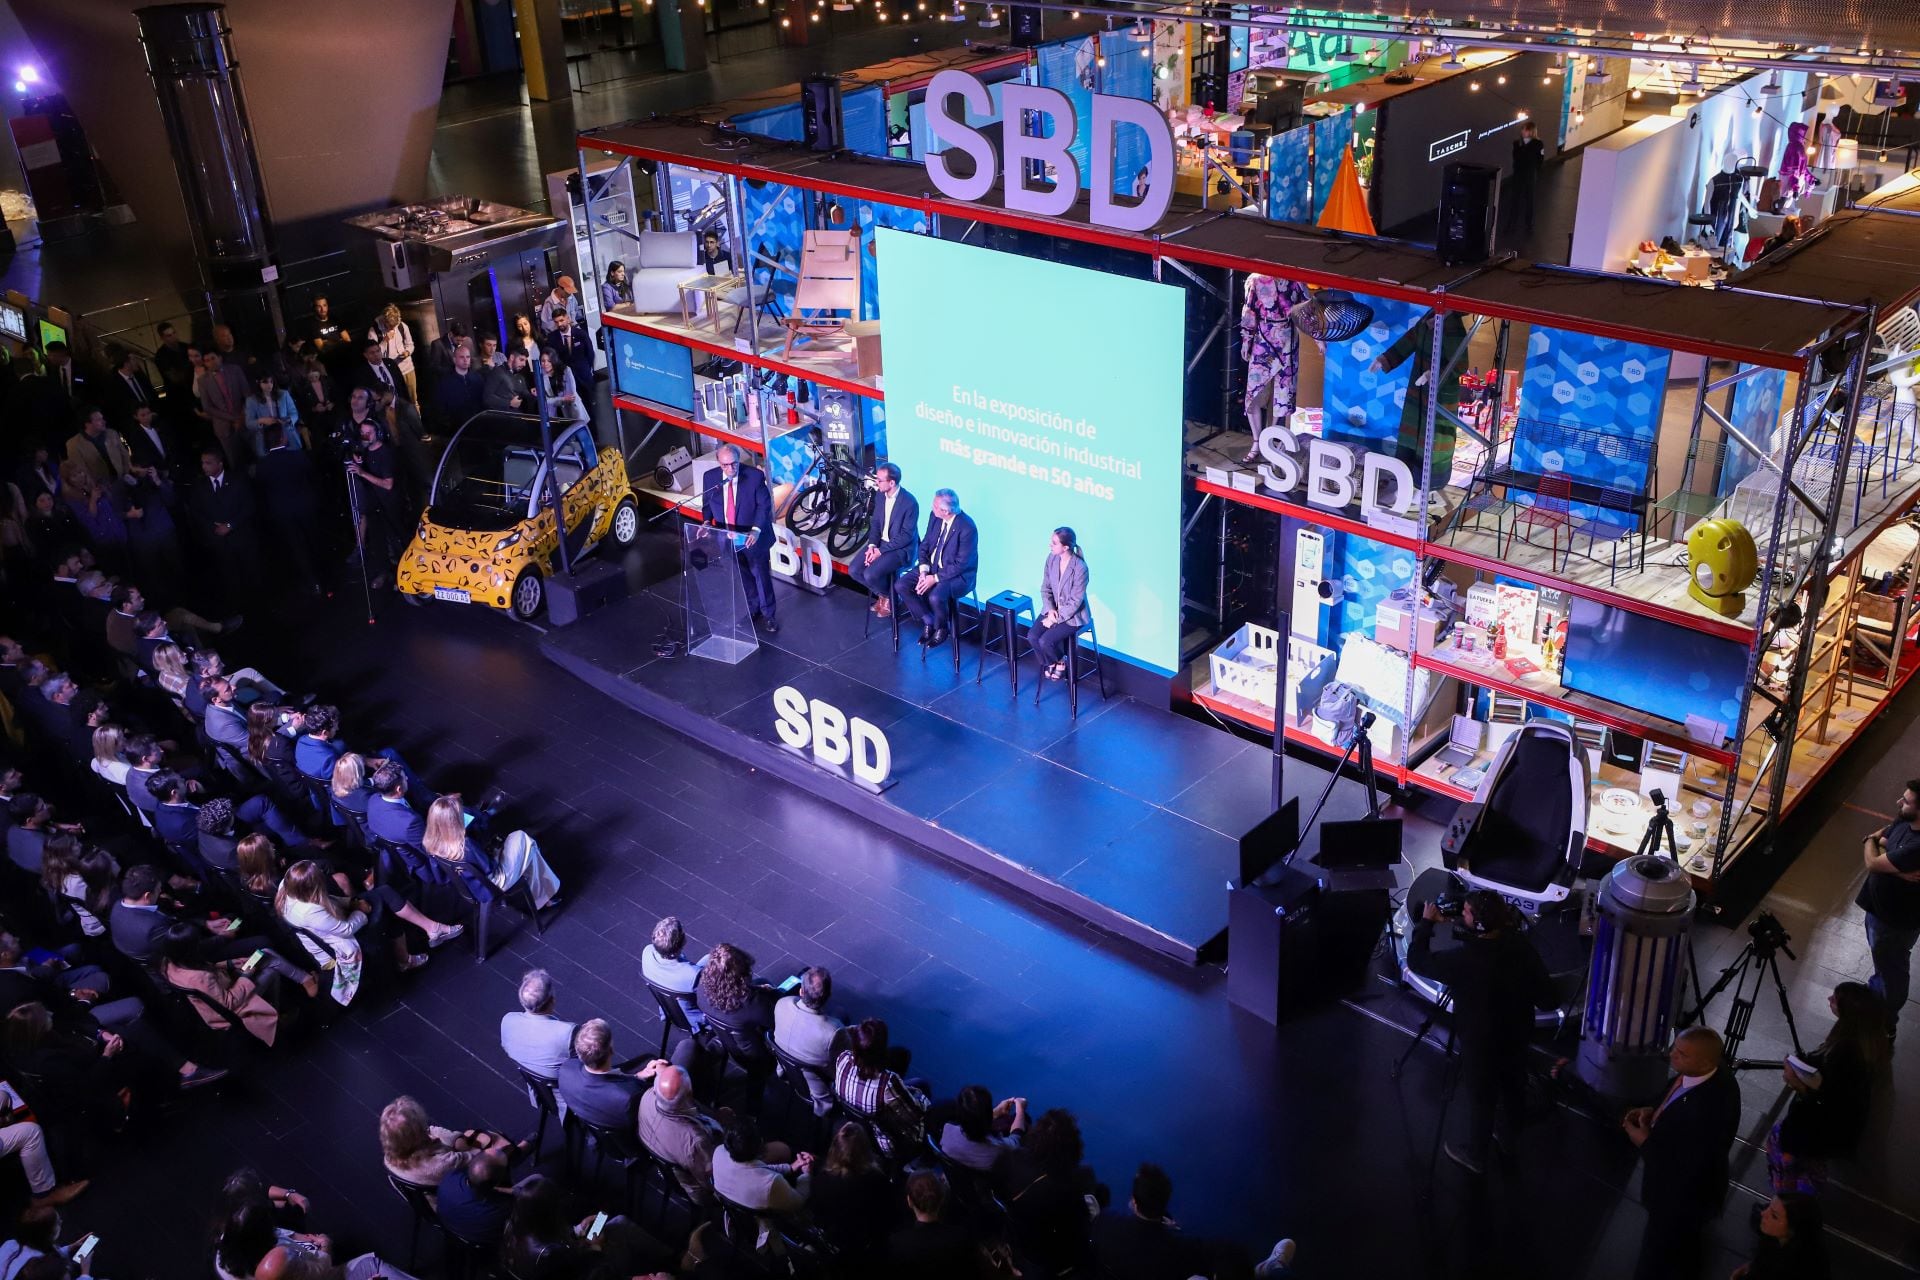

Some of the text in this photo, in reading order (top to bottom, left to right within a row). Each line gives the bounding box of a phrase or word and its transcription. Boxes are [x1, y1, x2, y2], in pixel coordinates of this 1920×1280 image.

[925, 69, 1176, 232] SBD
[1435, 140, 1463, 155] TASCHE
[915, 401, 1142, 480] diseño e innovación industrial
[953, 385, 1097, 440] En la exposición de
[939, 436, 1115, 502] más grande en 50 años
[1257, 424, 1414, 517] SBD
[769, 521, 833, 589] BD
[773, 685, 892, 785] SBD
